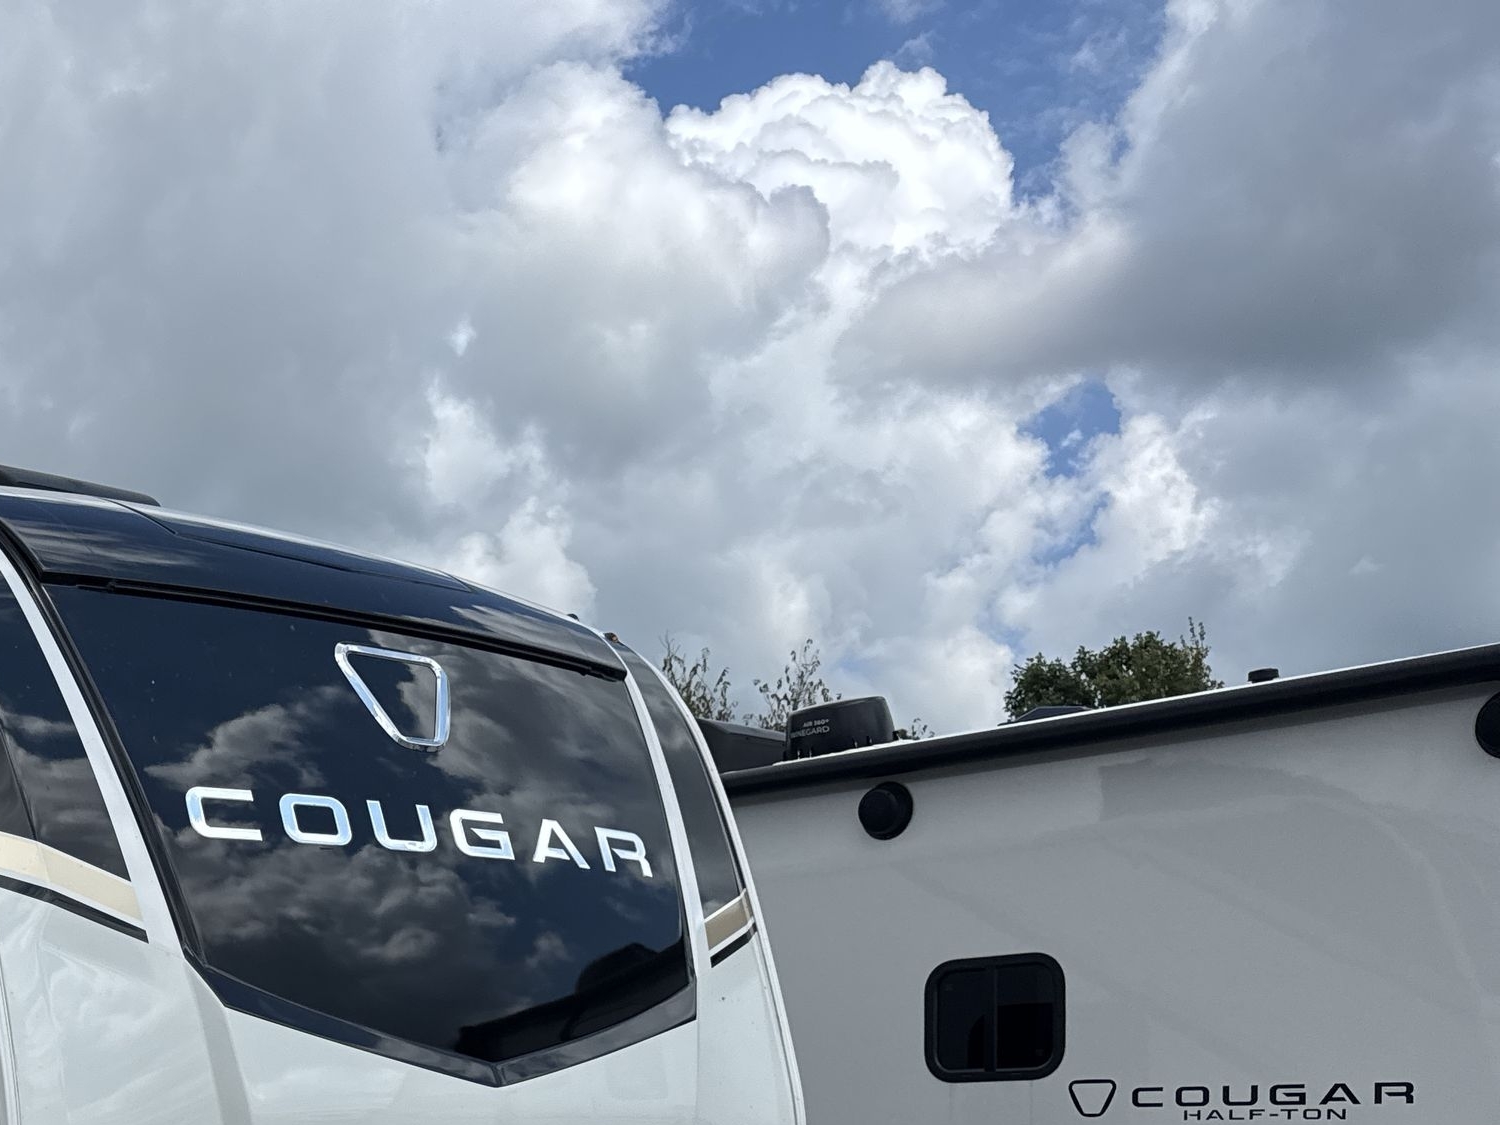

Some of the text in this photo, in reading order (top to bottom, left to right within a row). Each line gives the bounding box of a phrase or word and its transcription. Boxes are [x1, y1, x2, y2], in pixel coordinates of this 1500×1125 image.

[185, 786, 653, 878] COUGAR
[1131, 1081, 1415, 1108] COUGAR
[1183, 1108, 1347, 1121] HALF-TON
